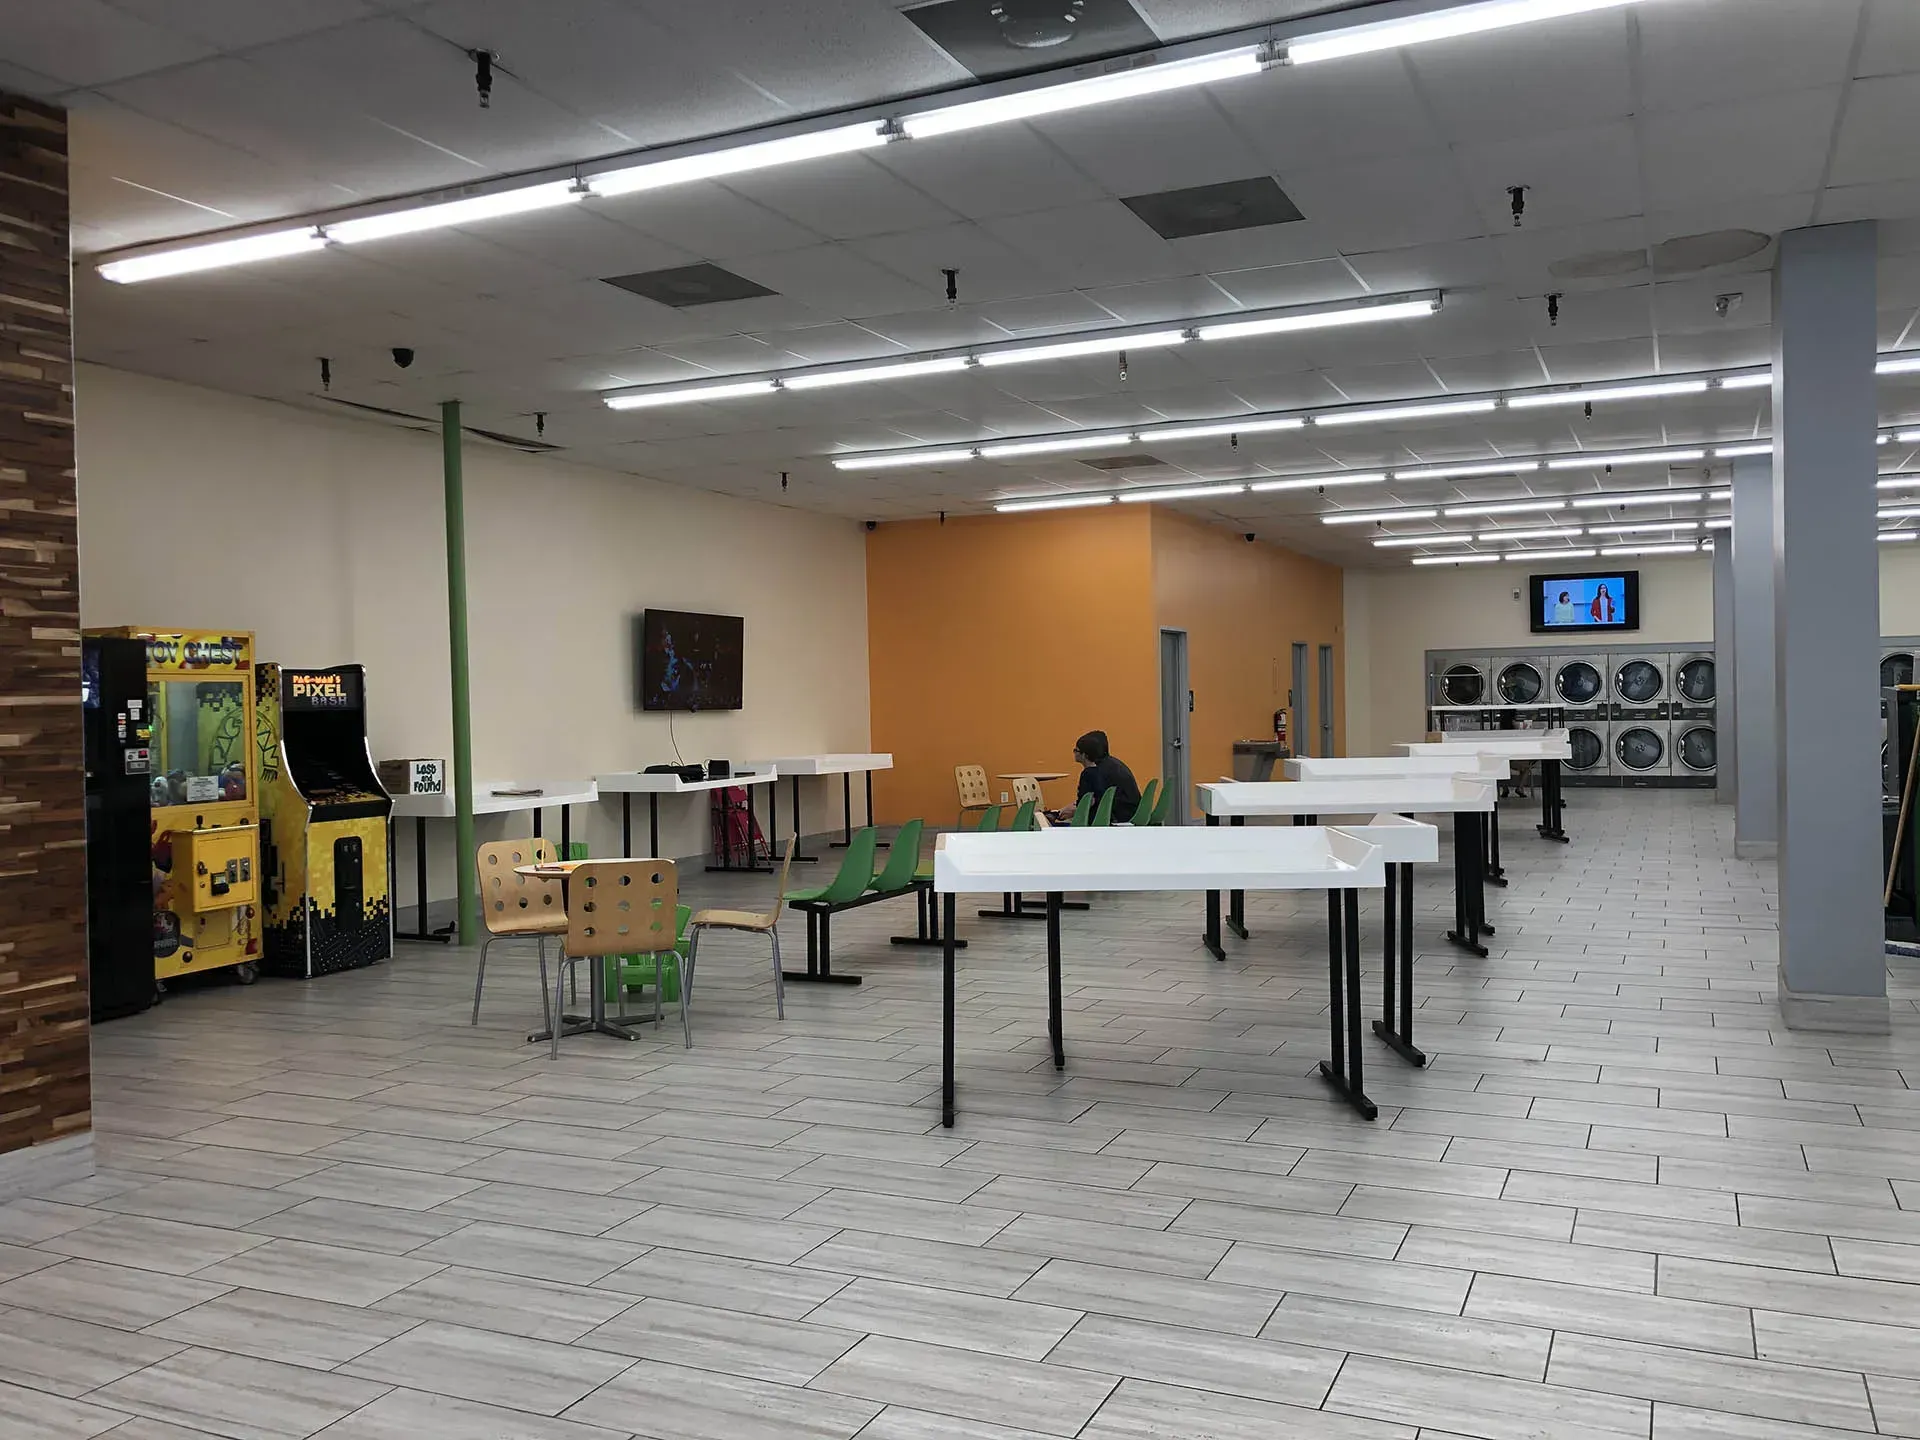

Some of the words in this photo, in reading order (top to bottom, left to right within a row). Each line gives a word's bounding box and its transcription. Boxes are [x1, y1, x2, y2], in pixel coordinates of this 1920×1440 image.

[146, 641, 178, 663] TOY
[183, 640, 243, 664] CHEST
[293, 683, 347, 697] PIXEL
[311, 696, 347, 706] BASH
[421, 774, 433, 782] and
[413, 779, 441, 792] Found
